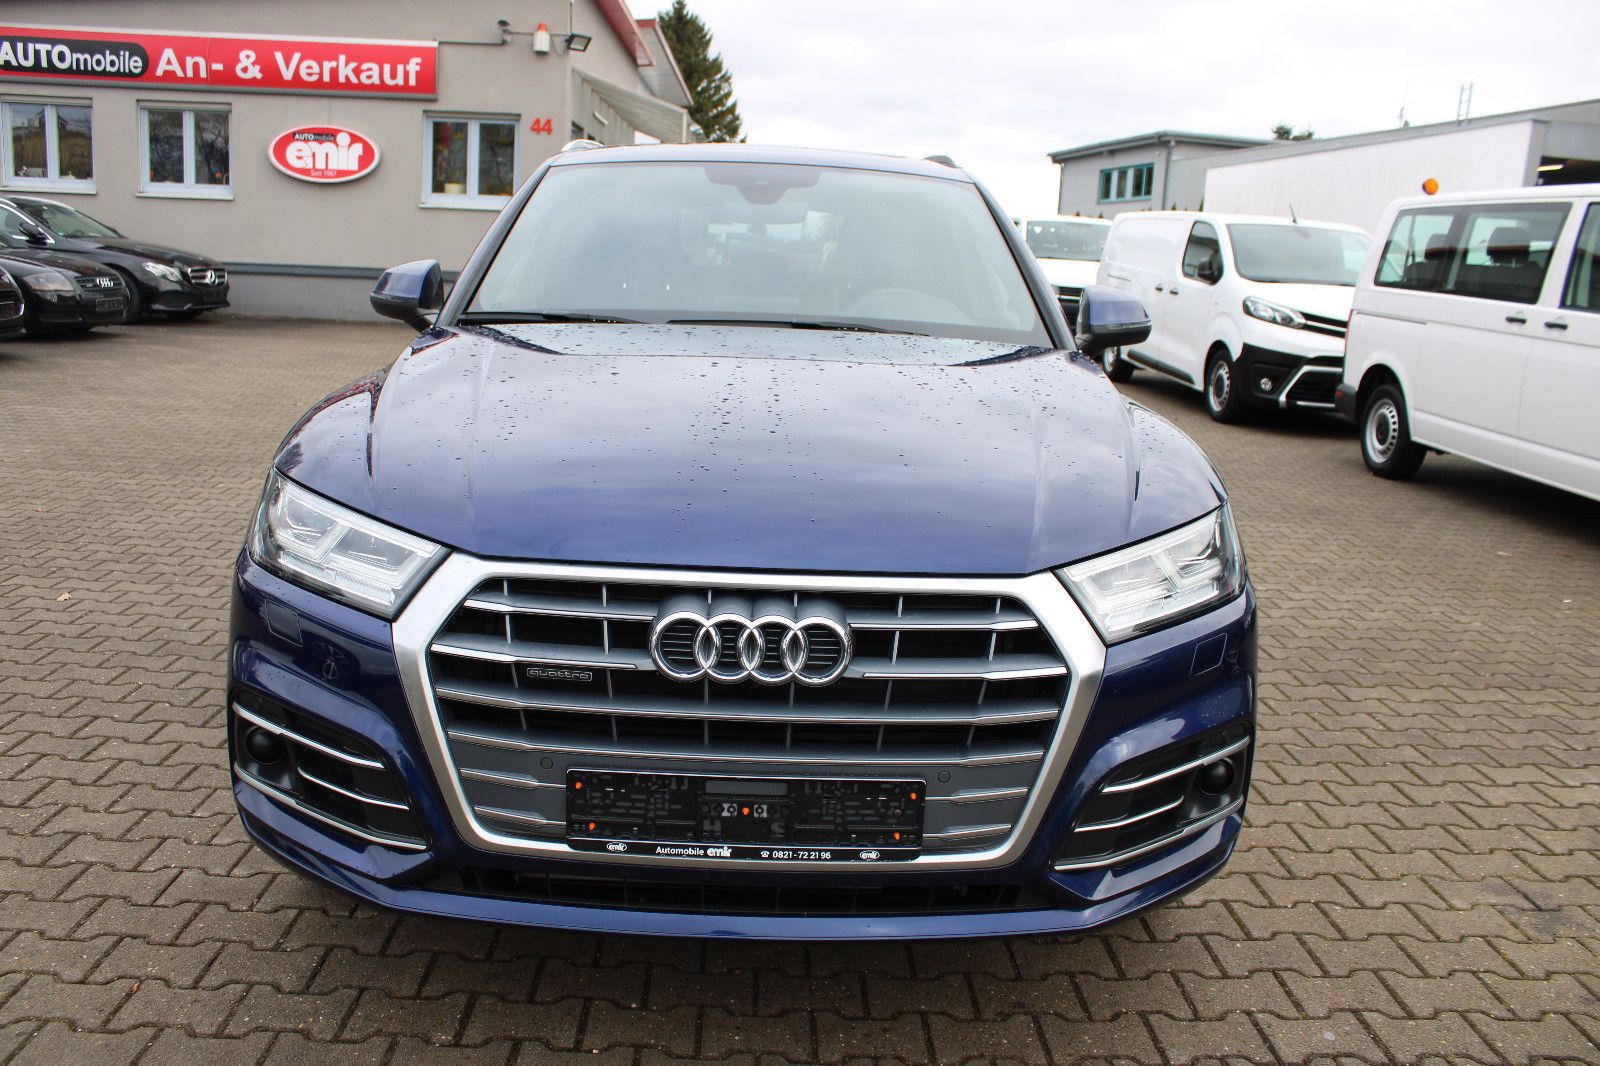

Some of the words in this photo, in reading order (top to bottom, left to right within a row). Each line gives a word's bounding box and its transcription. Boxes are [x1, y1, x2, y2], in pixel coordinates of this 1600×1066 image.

[0, 41, 143, 74] AUTOmobile
[155, 47, 224, 79] An-
[235, 49, 264, 80] &
[274, 51, 422, 87] Verkauf
[530, 117, 553, 136] 44
[286, 132, 363, 170] emir
[529, 669, 589, 679] quattro
[655, 846, 705, 856] Automobile
[706, 846, 733, 857] emir
